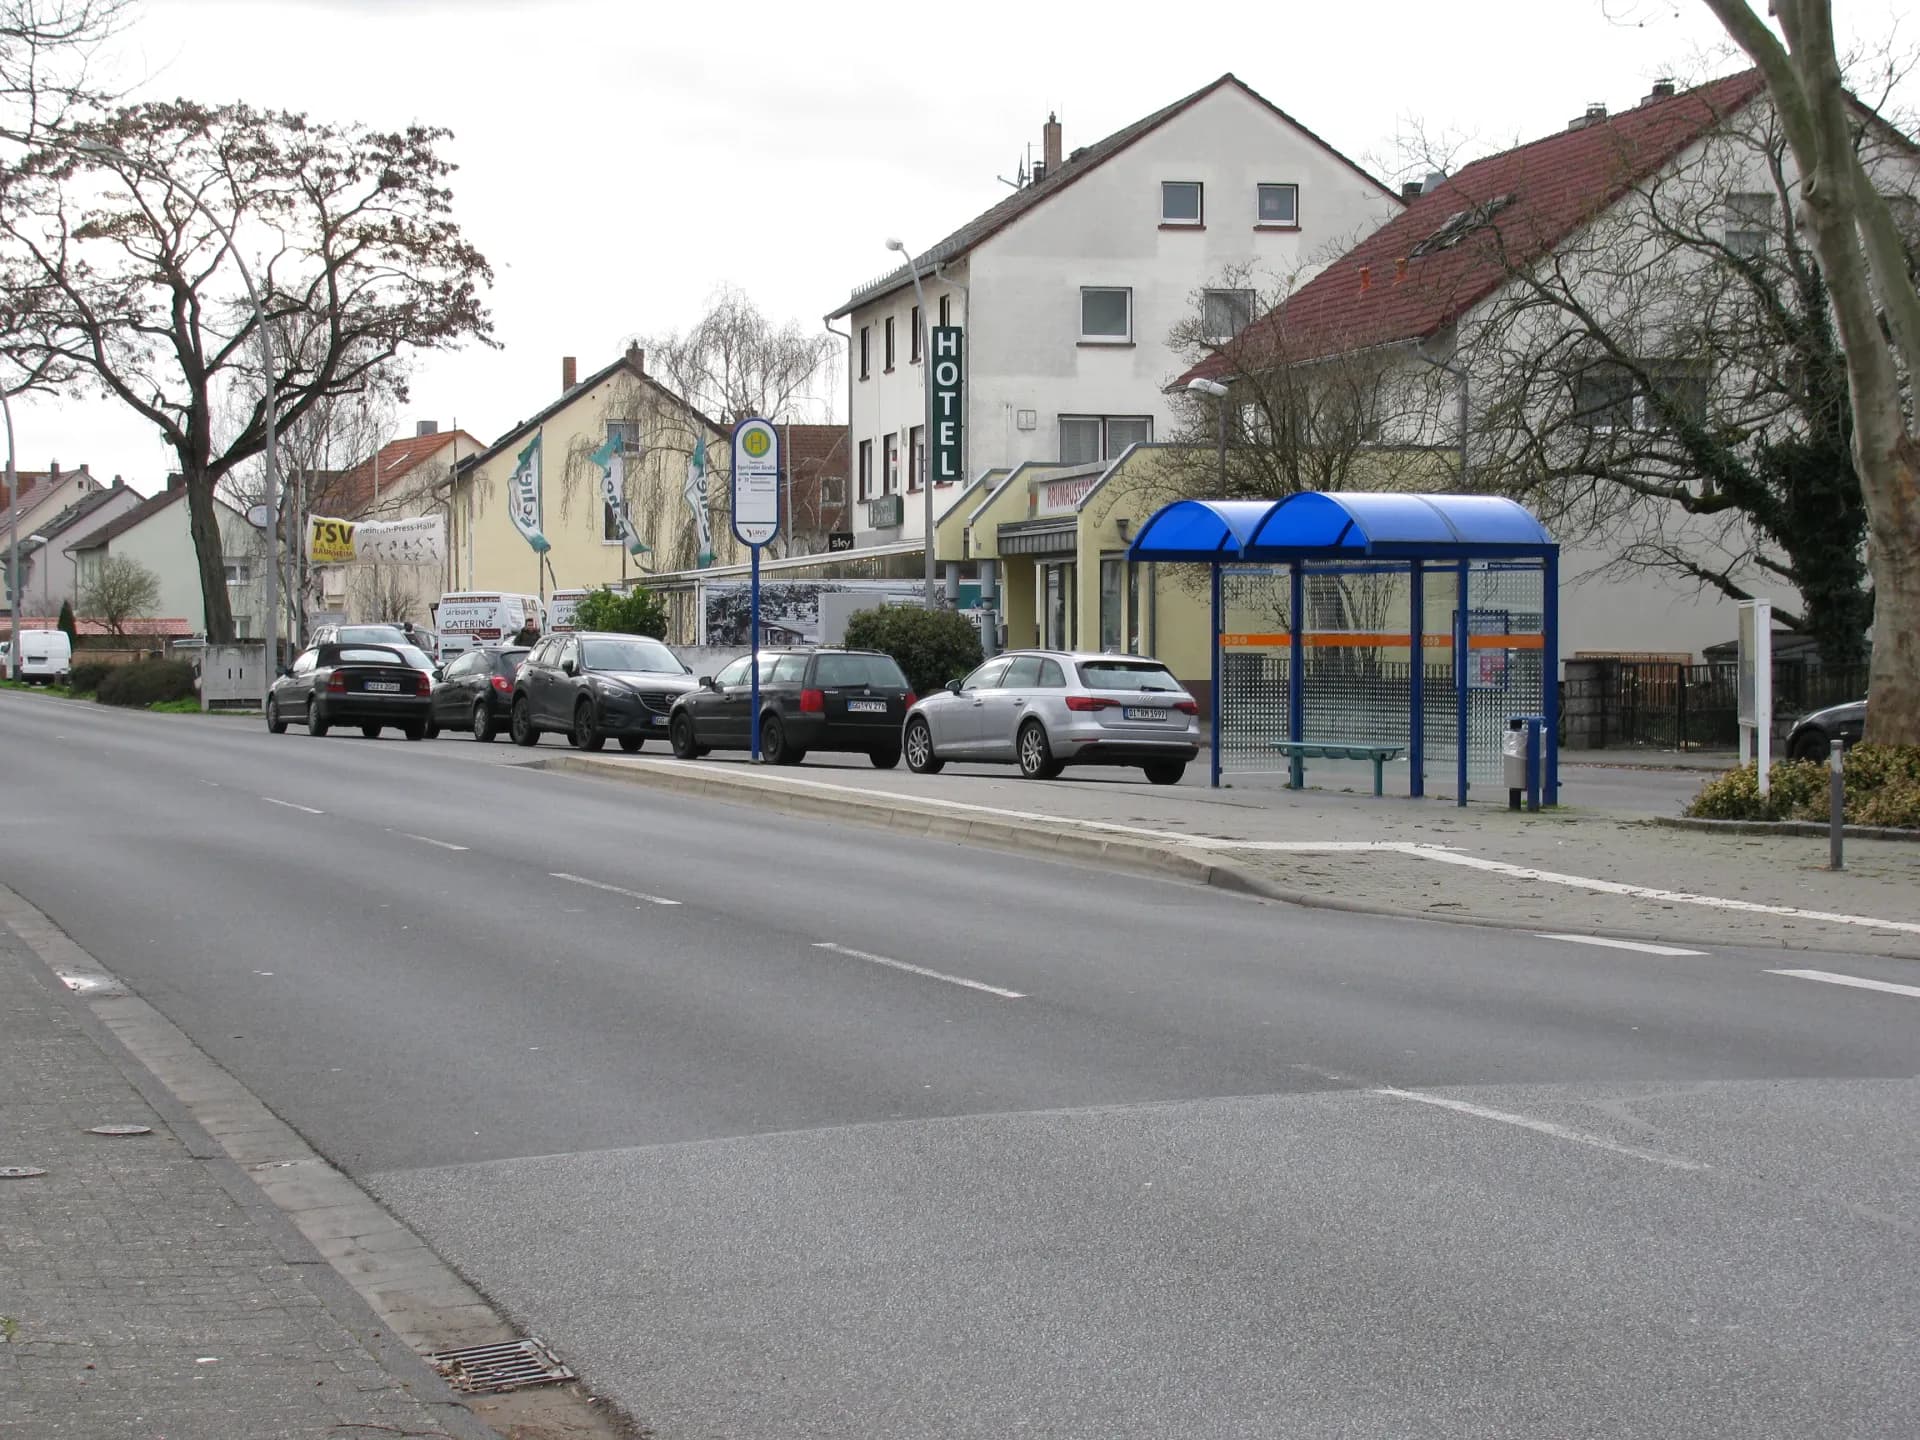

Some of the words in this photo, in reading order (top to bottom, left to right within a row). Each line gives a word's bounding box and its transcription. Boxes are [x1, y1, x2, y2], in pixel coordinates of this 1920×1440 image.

[936, 332, 958, 475] HOTEL
[313, 521, 355, 544] TSV
[832, 538, 850, 549] sky
[445, 619, 493, 629] CATERING
